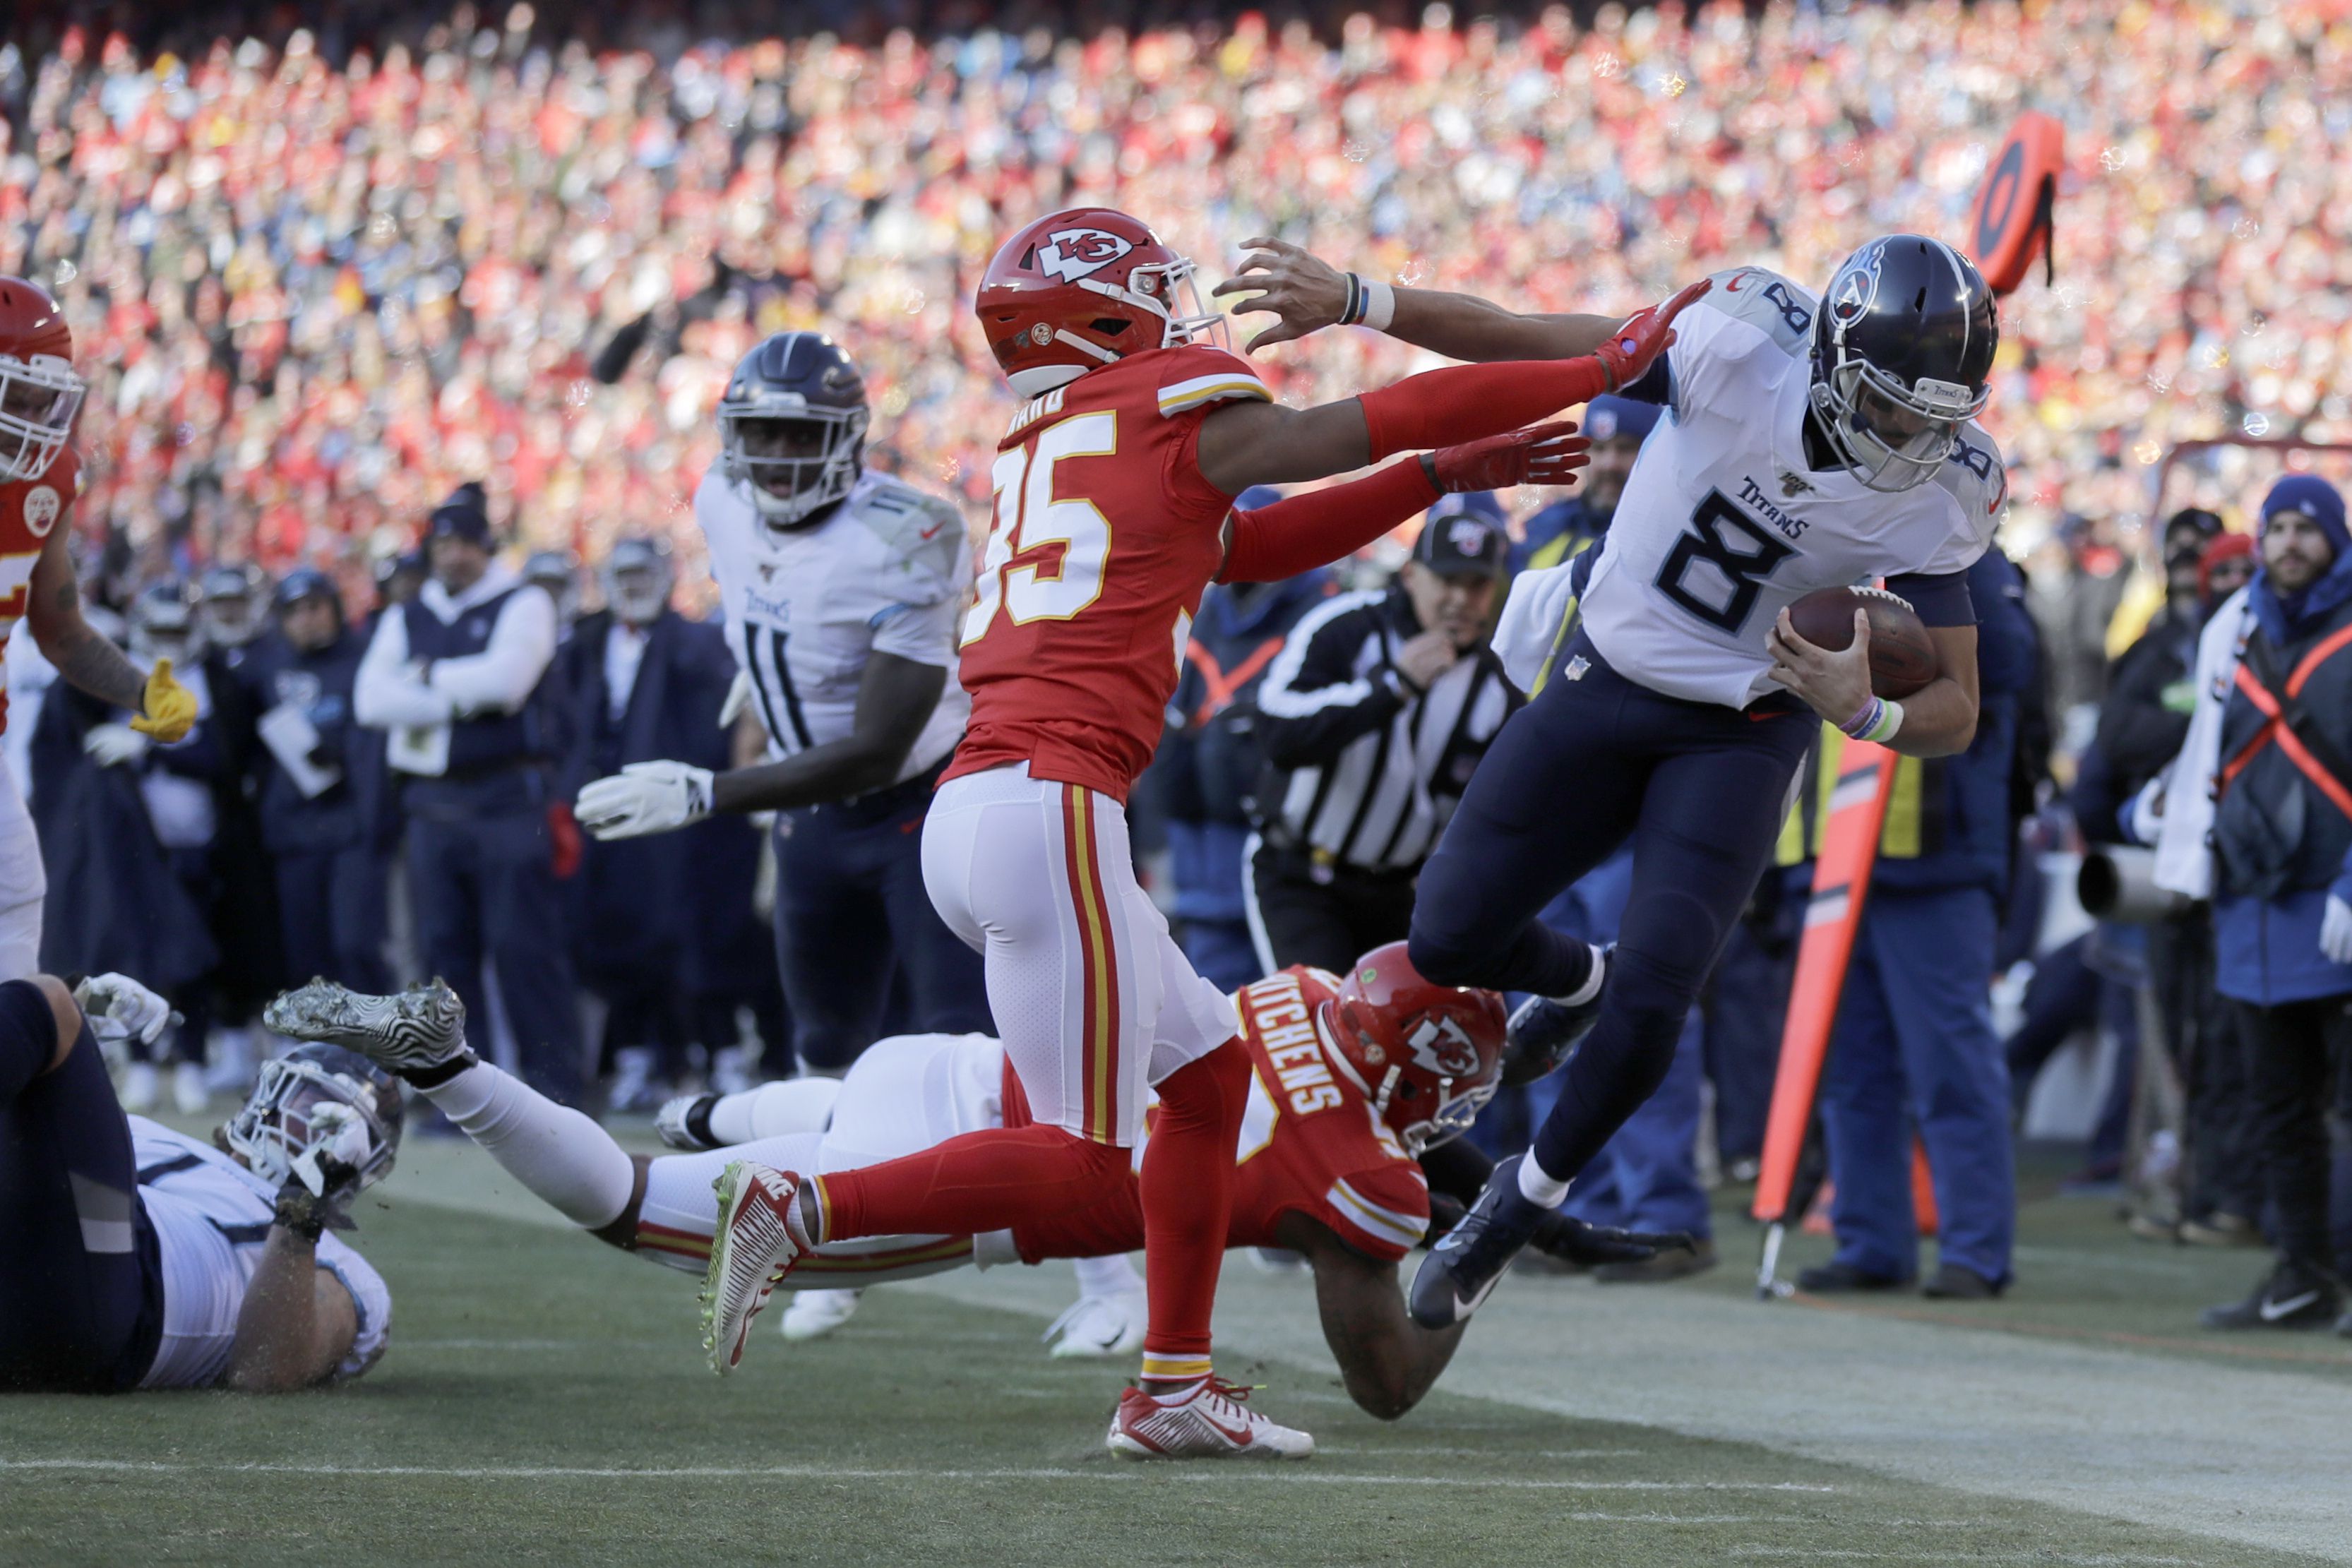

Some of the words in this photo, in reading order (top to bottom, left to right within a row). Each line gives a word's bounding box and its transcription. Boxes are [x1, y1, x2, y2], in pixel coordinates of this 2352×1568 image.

[1055, 232, 1119, 263] KC
[1760, 281, 1813, 337] 8
[1946, 433, 1993, 483] 8
[959, 409, 1116, 649] 35
[1736, 475, 1810, 539] TITANS
[1652, 485, 1804, 638] 8
[744, 619, 814, 750] 11
